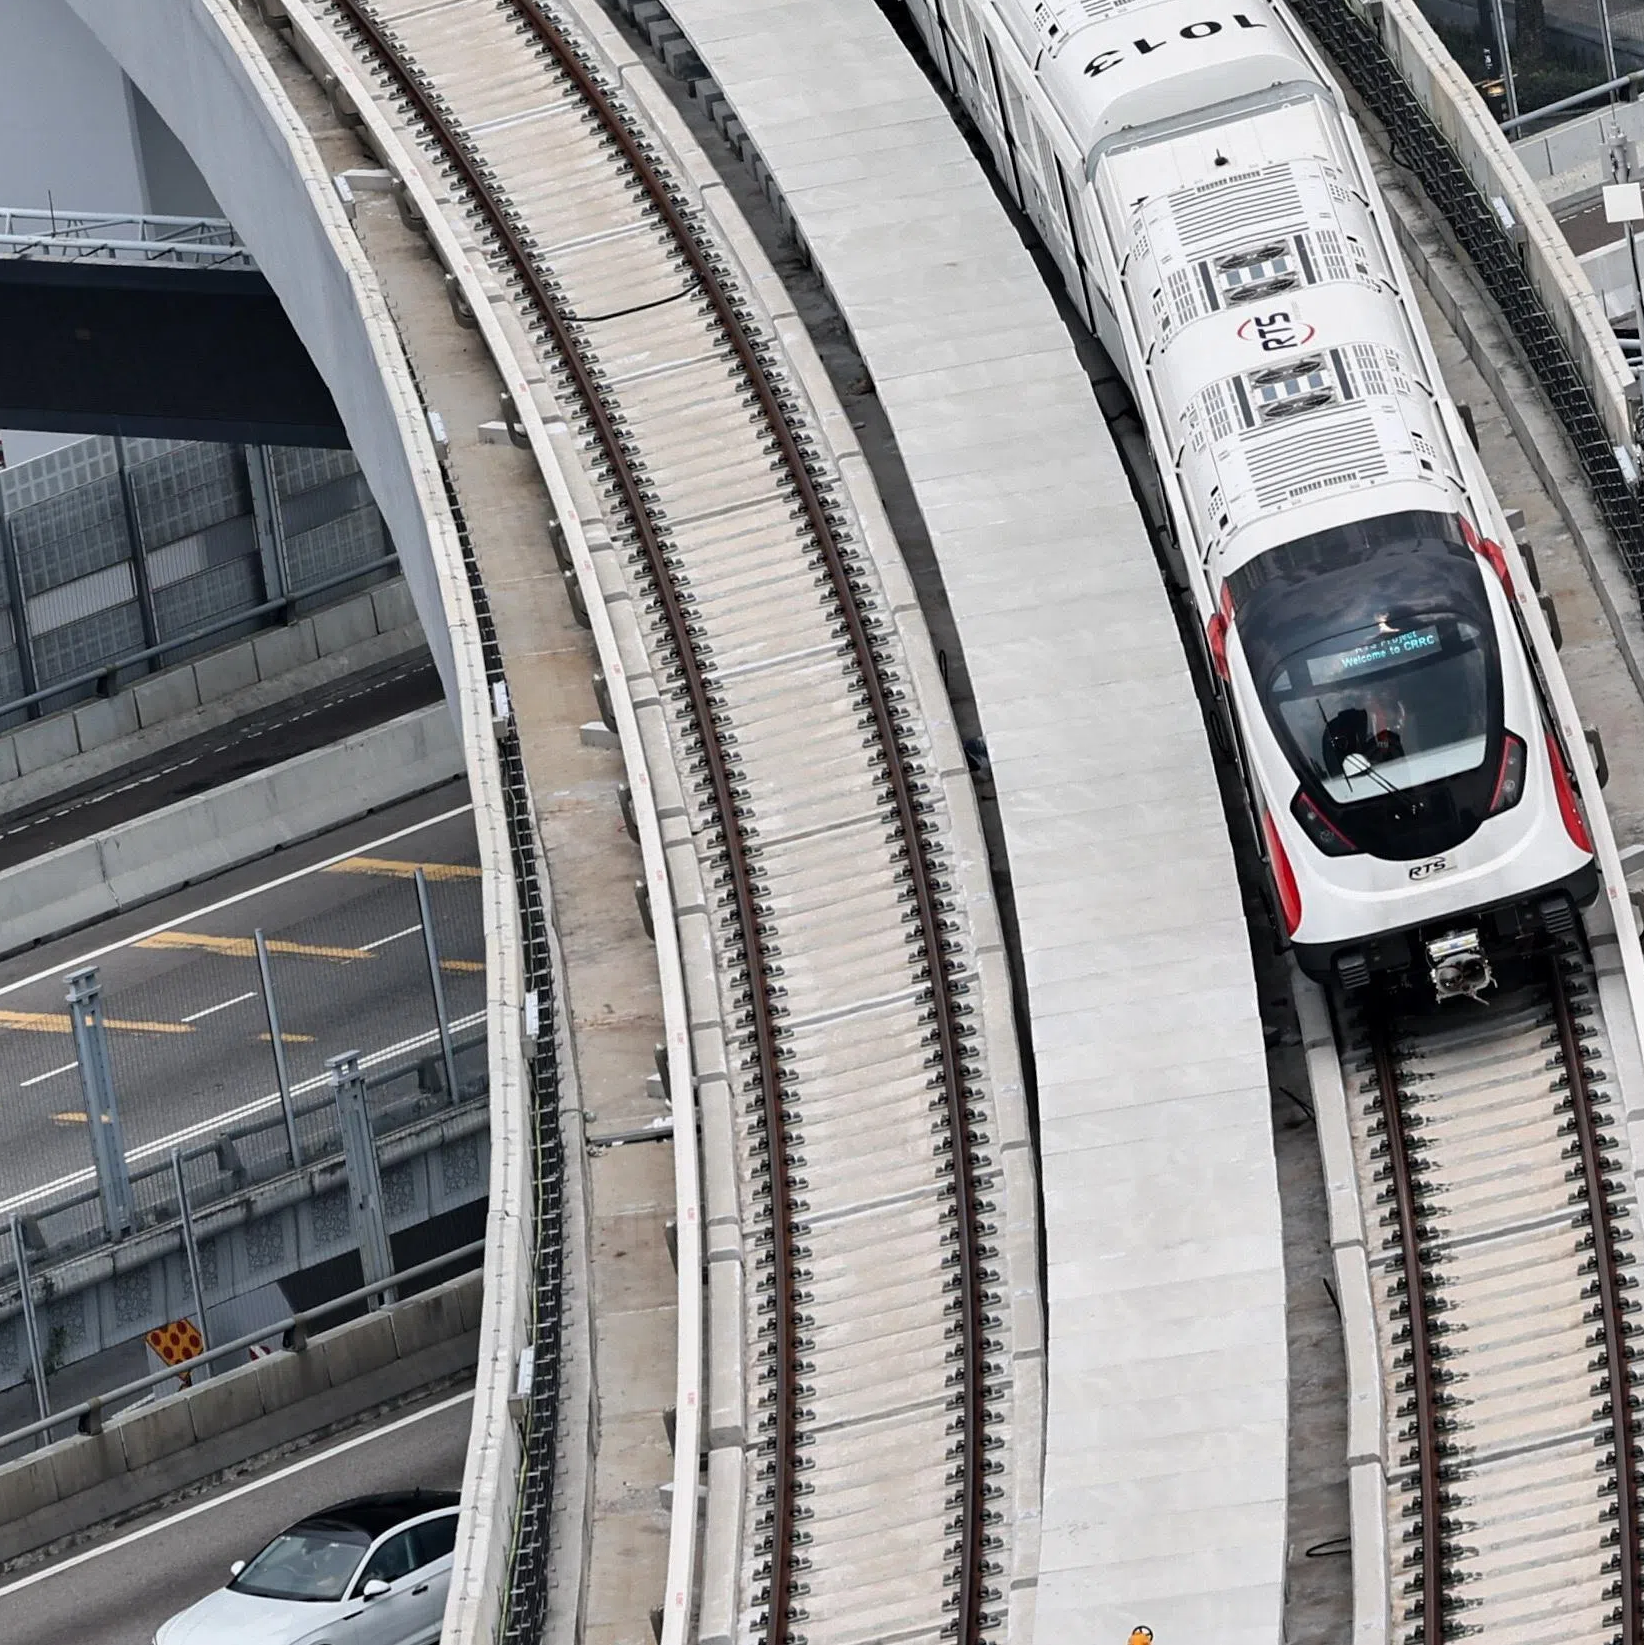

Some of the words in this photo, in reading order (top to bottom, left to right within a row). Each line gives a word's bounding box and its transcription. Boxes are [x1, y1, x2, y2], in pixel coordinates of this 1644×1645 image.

[1083, 13, 1268, 78] 1013
[1254, 311, 1298, 353] RTS
[1341, 649, 1387, 669] Welcome
[1389, 645, 1401, 656] to
[1403, 634, 1435, 652] CRRC
[1408, 858, 1446, 879] RTS
